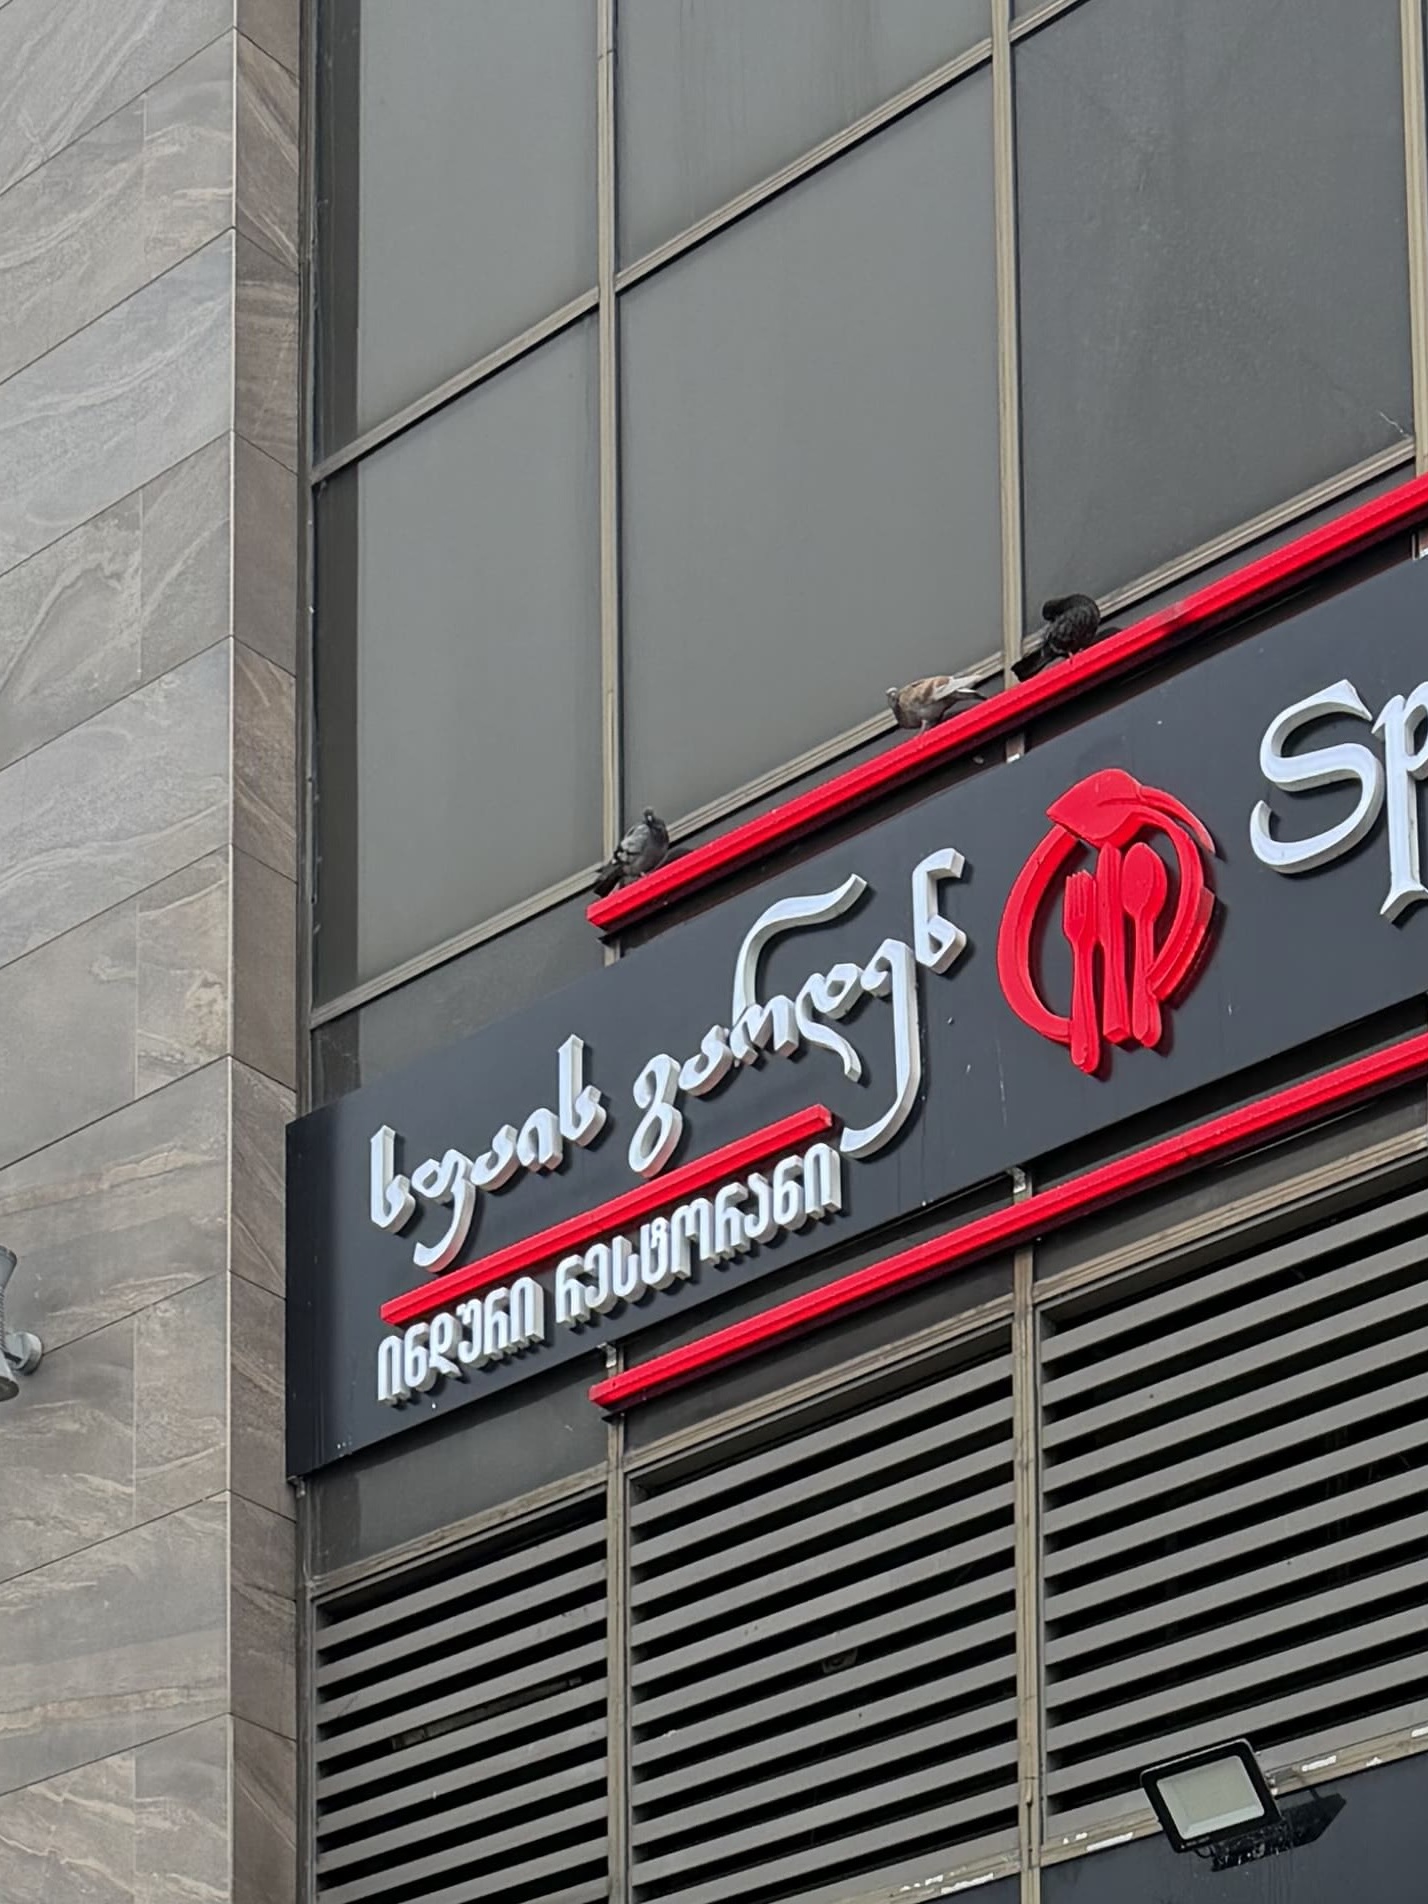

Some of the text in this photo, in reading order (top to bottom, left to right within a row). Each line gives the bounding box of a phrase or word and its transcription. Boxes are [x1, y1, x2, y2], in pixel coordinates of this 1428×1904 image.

[628, 846, 968, 1179] გარდენ
[376, 1141, 844, 1406] ინდური რესტორანი
